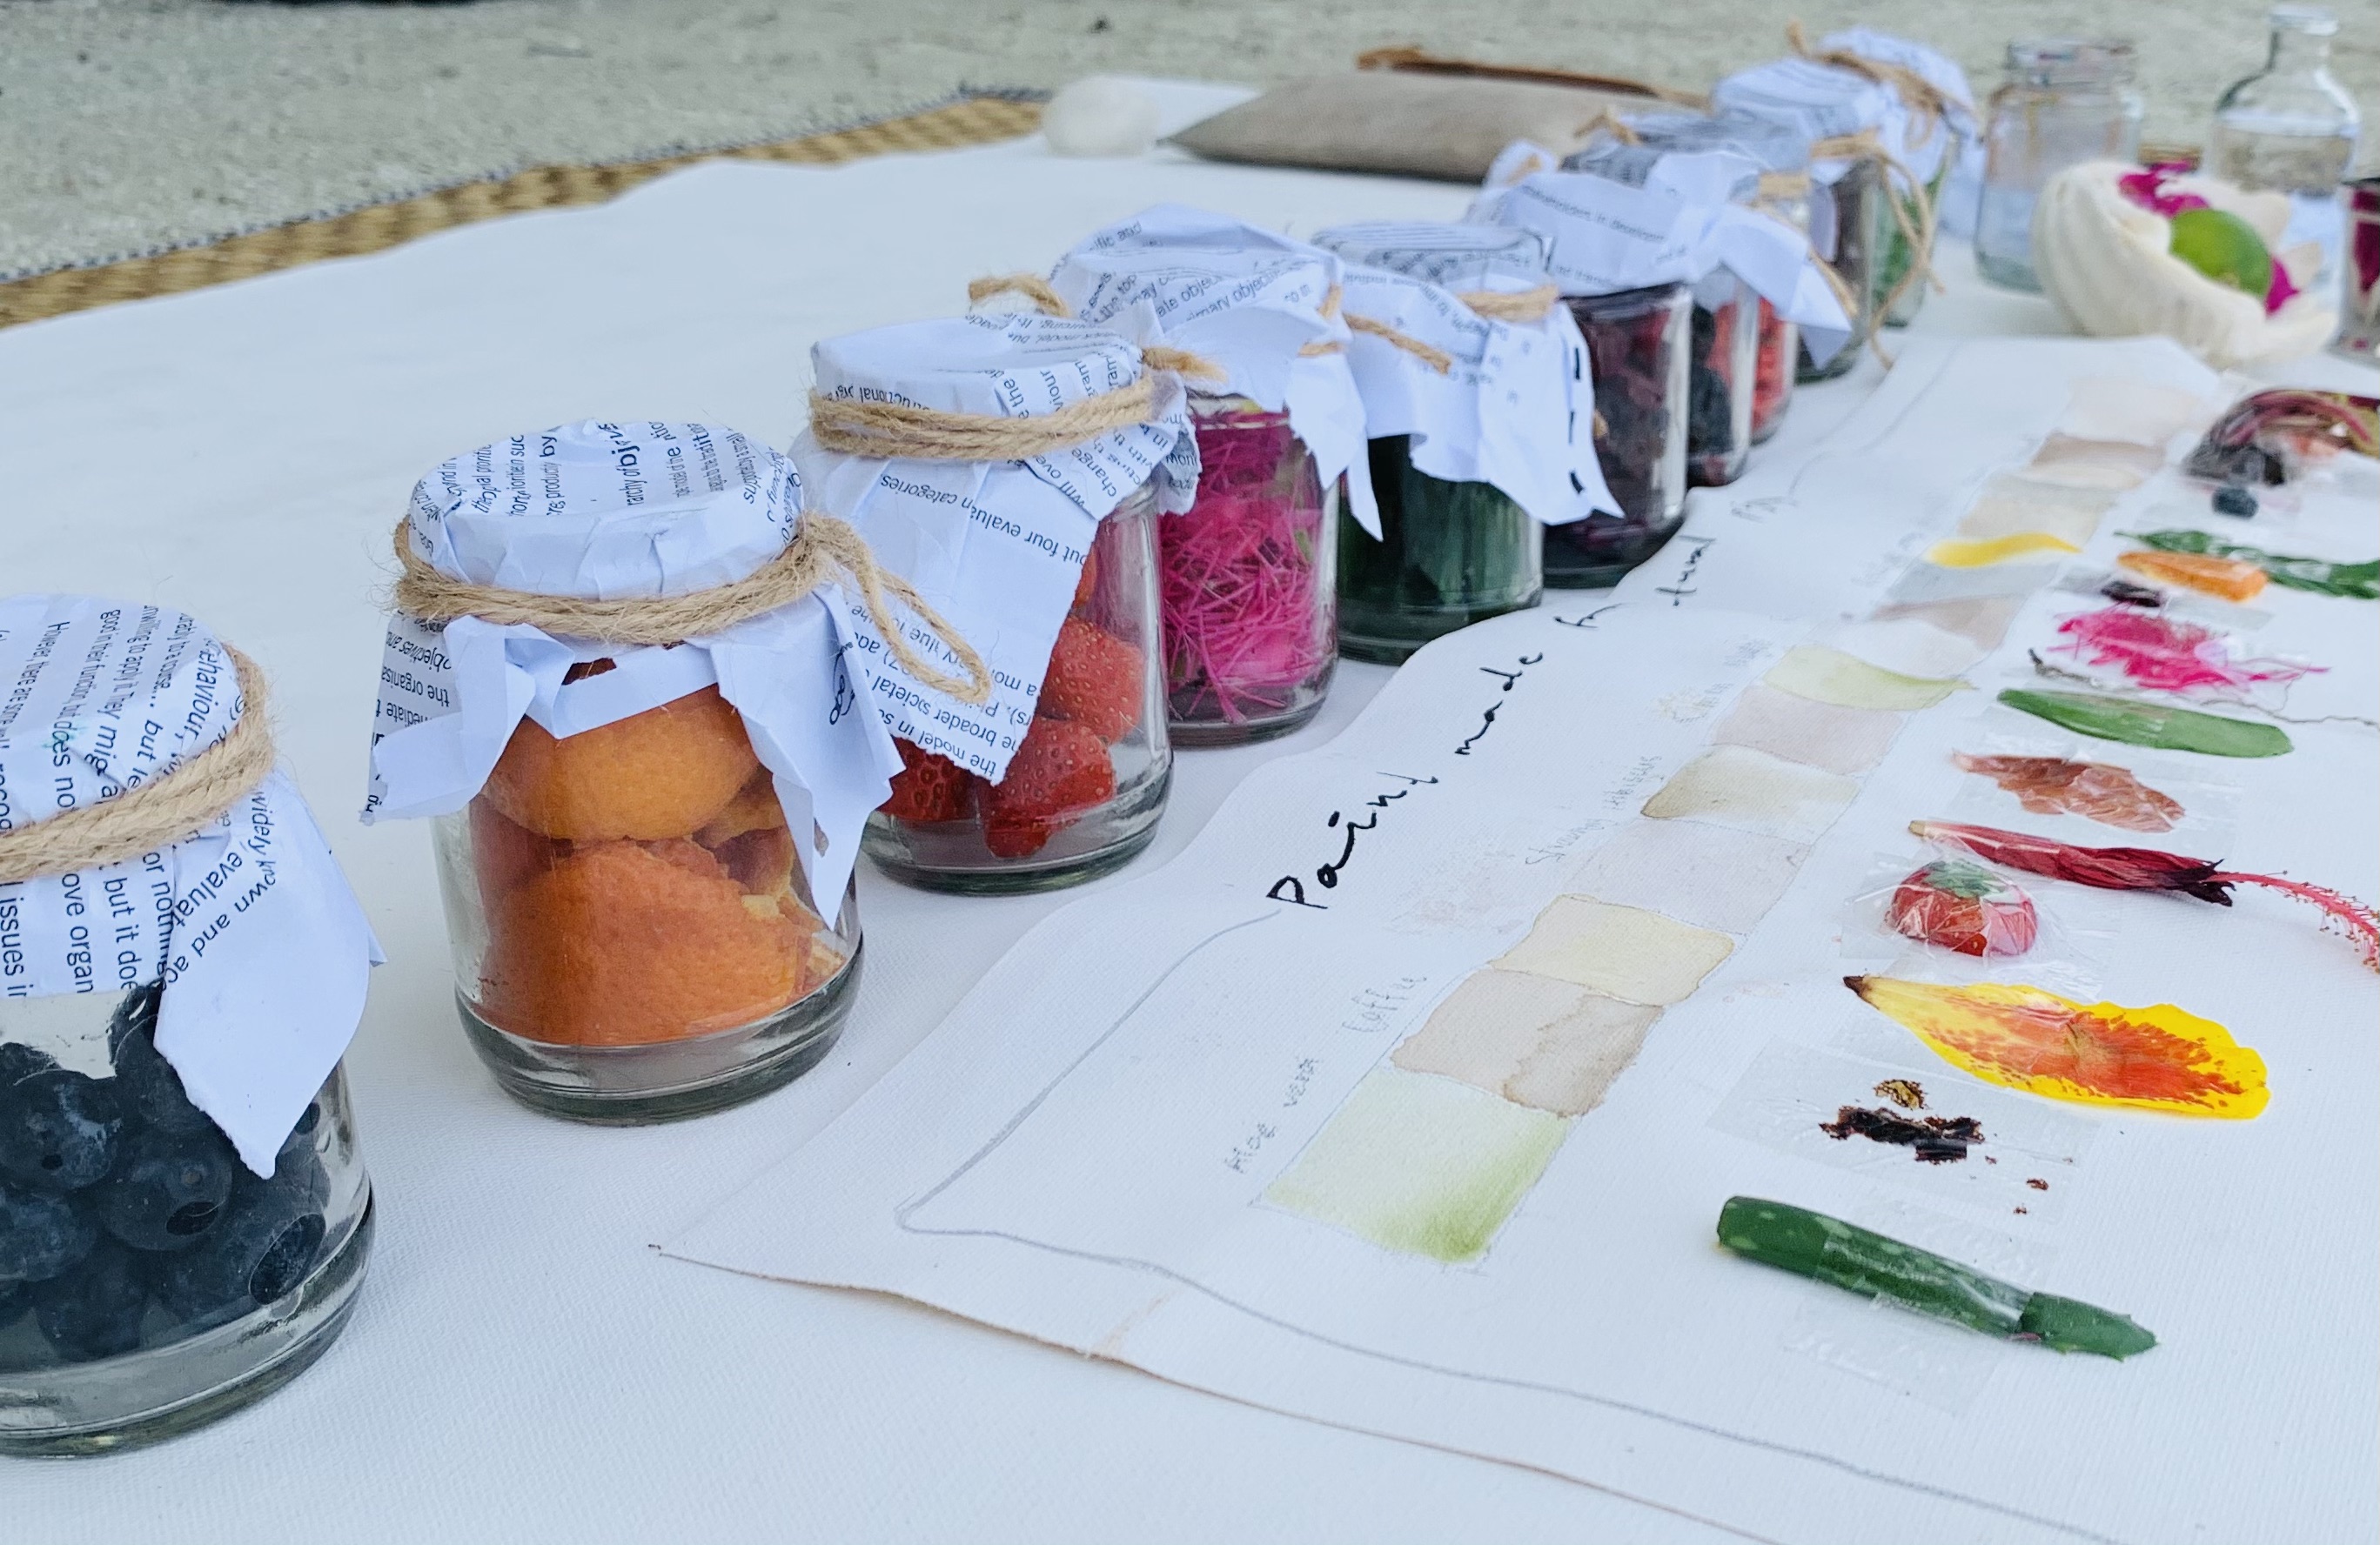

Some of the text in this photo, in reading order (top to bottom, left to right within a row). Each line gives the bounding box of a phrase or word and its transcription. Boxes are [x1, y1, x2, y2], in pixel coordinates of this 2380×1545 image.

[539, 436, 558, 458] by
[881, 473, 958, 505] categories.
[1023, 530, 1060, 558] four
[100, 609, 121, 633] good
[26, 621, 70, 662] However,
[427, 684, 450, 707] the
[871, 675, 931, 716] societal
[1026, 683, 1038, 697] a
[51, 720, 78, 768] does
[136, 719, 164, 763] but
[898, 718, 915, 736] in
[918, 730, 966, 759] model
[932, 708, 997, 747] broader
[969, 753, 997, 777] the
[1265, 651, 1544, 910] Paint made
[54, 777, 77, 809] no
[247, 792, 275, 856] widely
[142, 851, 164, 873] or
[103, 877, 136, 919] but
[176, 851, 243, 928] evaluat
[234, 859, 277, 913] known
[0, 897, 26, 976] issues
[115, 923, 140, 944] it
[191, 913, 231, 958] and
[66, 925, 95, 994] organ
